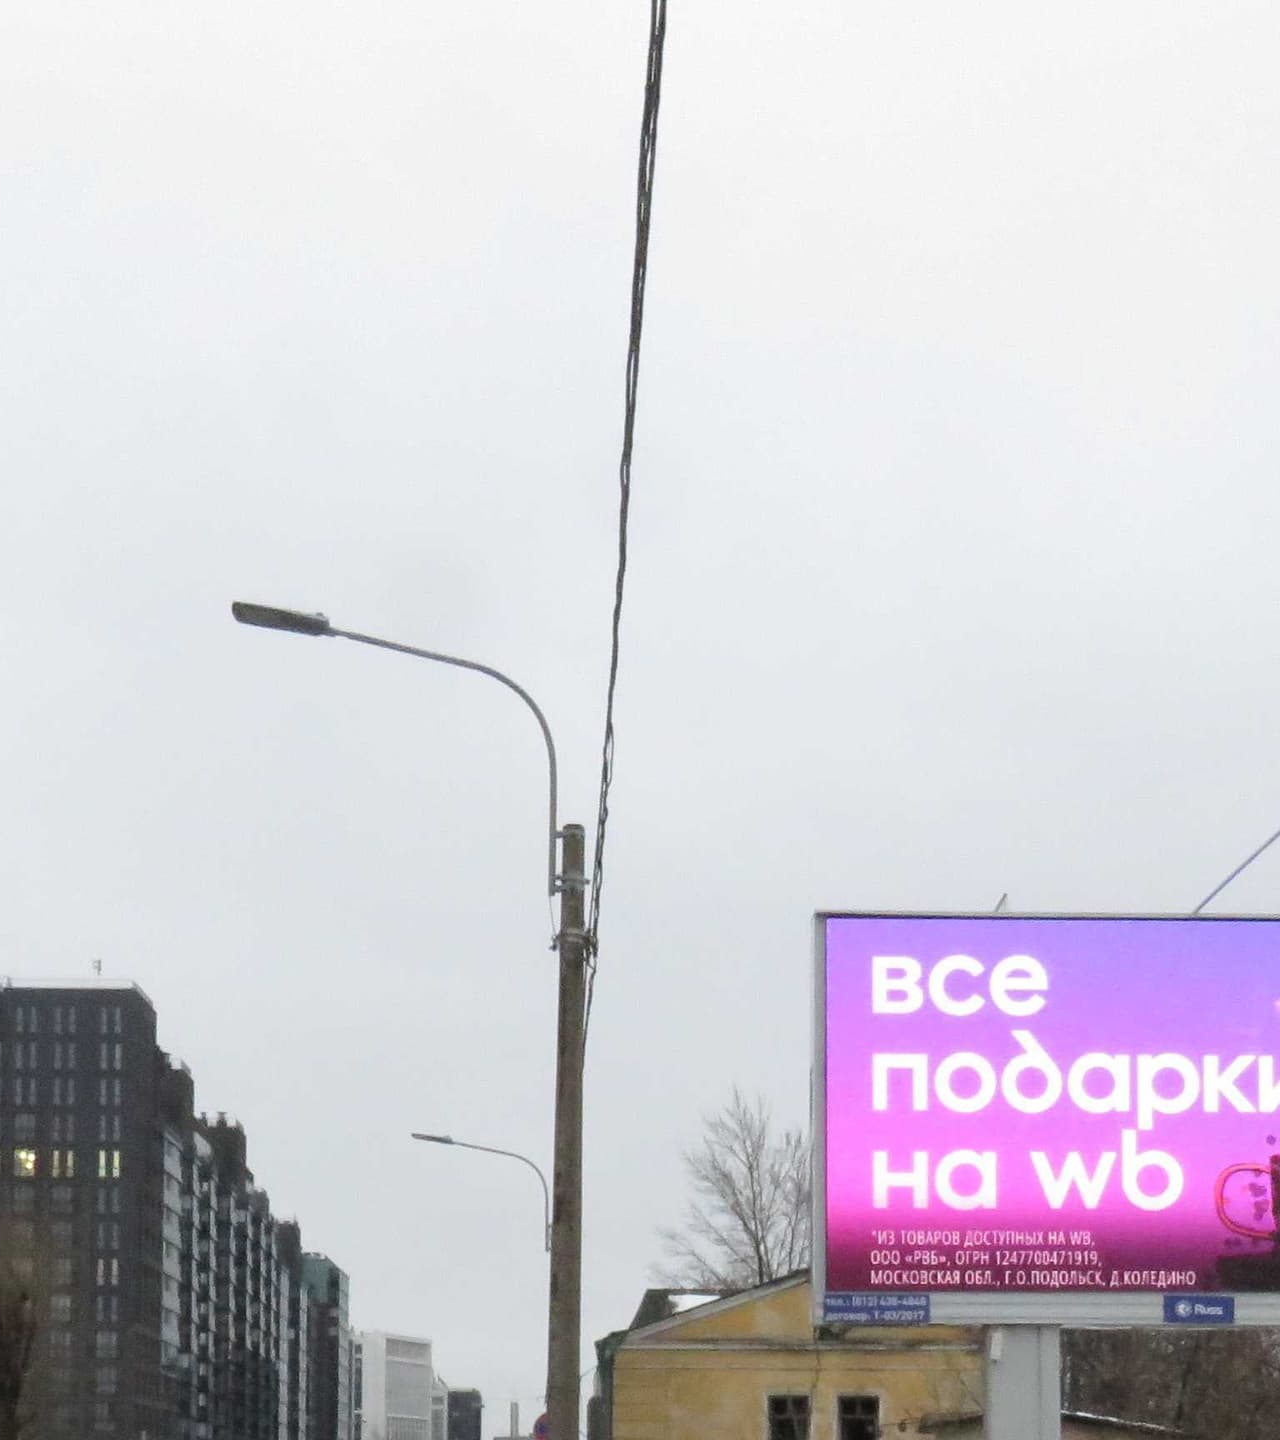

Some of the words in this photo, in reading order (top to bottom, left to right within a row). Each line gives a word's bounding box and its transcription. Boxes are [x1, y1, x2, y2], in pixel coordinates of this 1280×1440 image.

[871, 953, 1049, 1017] все
[872, 1148, 998, 1212] на
[1029, 1128, 1185, 1212] wb
[900, 1229, 960, 1246] ТОВАРОВ
[963, 1229, 1045, 1247] ДОСТУПНЫХ
[1048, 1230, 1066, 1246] НА
[870, 1249, 901, 1265] ООО
[954, 1250, 990, 1266] ОГРН
[870, 1269, 960, 1285] МОСКОВСКАЯ
